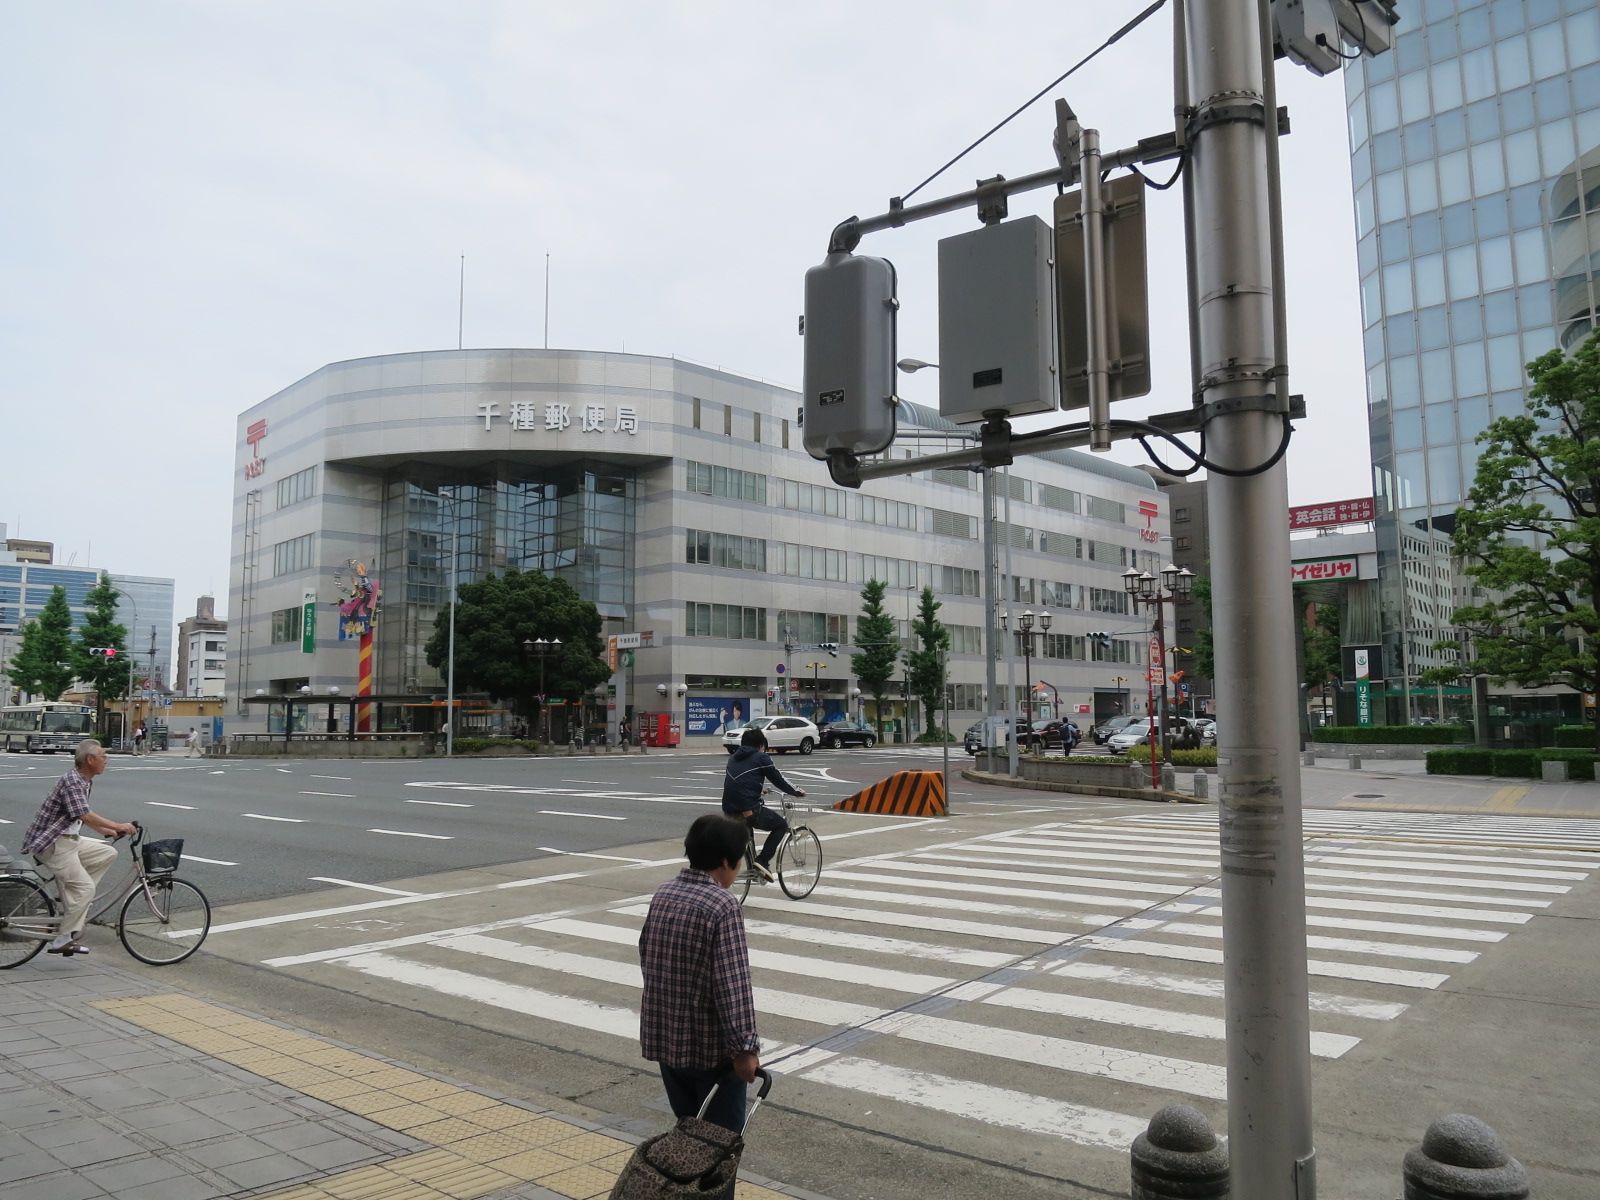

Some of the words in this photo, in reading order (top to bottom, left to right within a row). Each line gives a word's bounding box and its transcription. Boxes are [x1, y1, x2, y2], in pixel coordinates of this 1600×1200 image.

[476, 400, 640, 435] 千種郵便局
[1296, 507, 1336, 524] 英会話
[1359, 685, 1369, 724] りそな銀行
